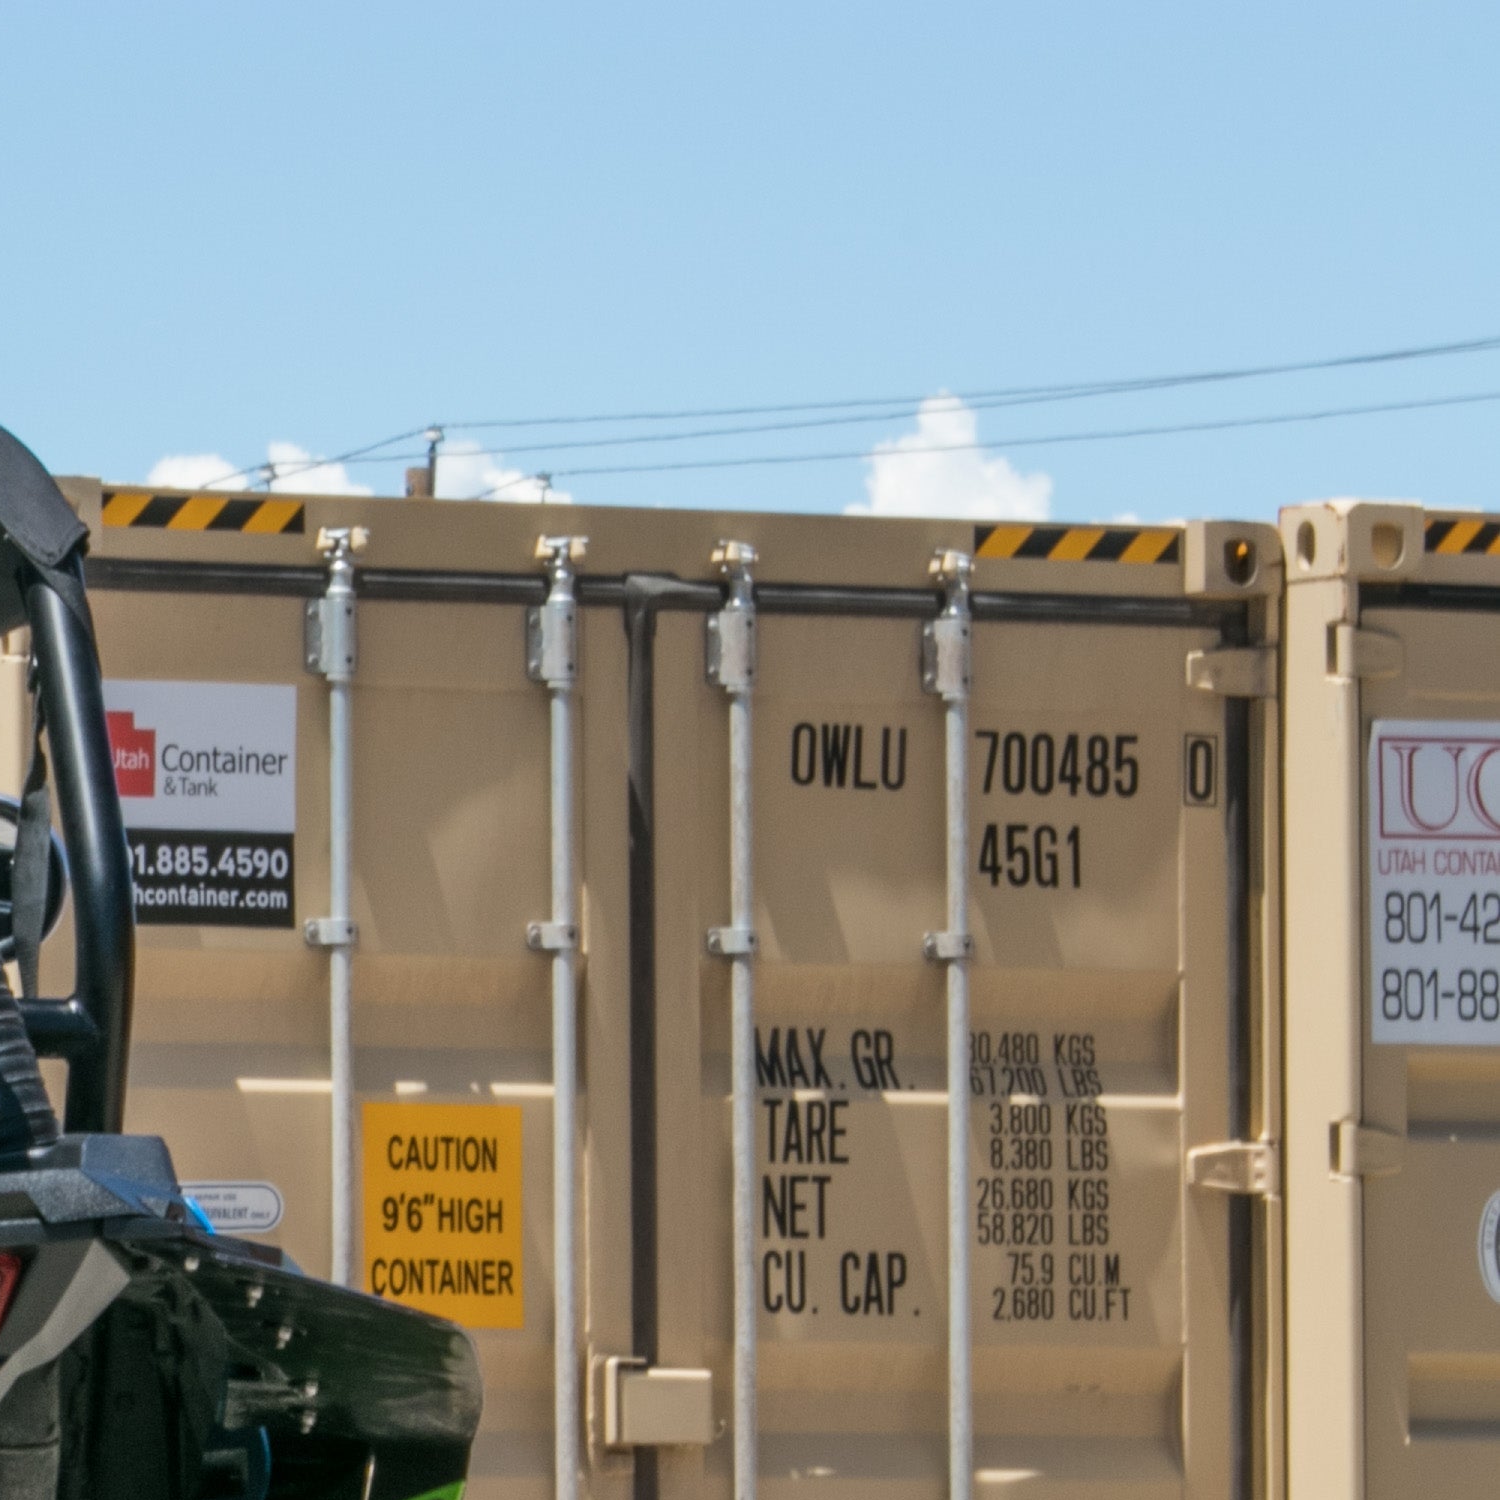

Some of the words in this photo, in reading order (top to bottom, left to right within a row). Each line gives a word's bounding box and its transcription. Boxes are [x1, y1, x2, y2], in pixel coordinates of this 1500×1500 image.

[161, 744, 288, 775] Container
[791, 722, 908, 791] OWLU
[975, 730, 1139, 798] 700485
[164, 777, 177, 796] &
[181, 777, 218, 797] Tank
[978, 823, 1082, 889] 45G1
[1377, 848, 1426, 875] UTAH
[1434, 848, 1500, 875] CONTA
[1053, 1033, 1096, 1067] KGS
[762, 1098, 850, 1164] TARE
[1066, 1103, 1108, 1137] KGS
[387, 1135, 498, 1172] CAUTION
[1066, 1138, 1109, 1172] LBS
[762, 1175, 832, 1239] NET
[1067, 1178, 1109, 1212] KGS
[1067, 1213, 1109, 1247] LBS
[371, 1257, 514, 1297] CONTAINER
[763, 1250, 819, 1315] CU.
[840, 1251, 921, 1317] CAP.
[1006, 1252, 1054, 1286] 75.9
